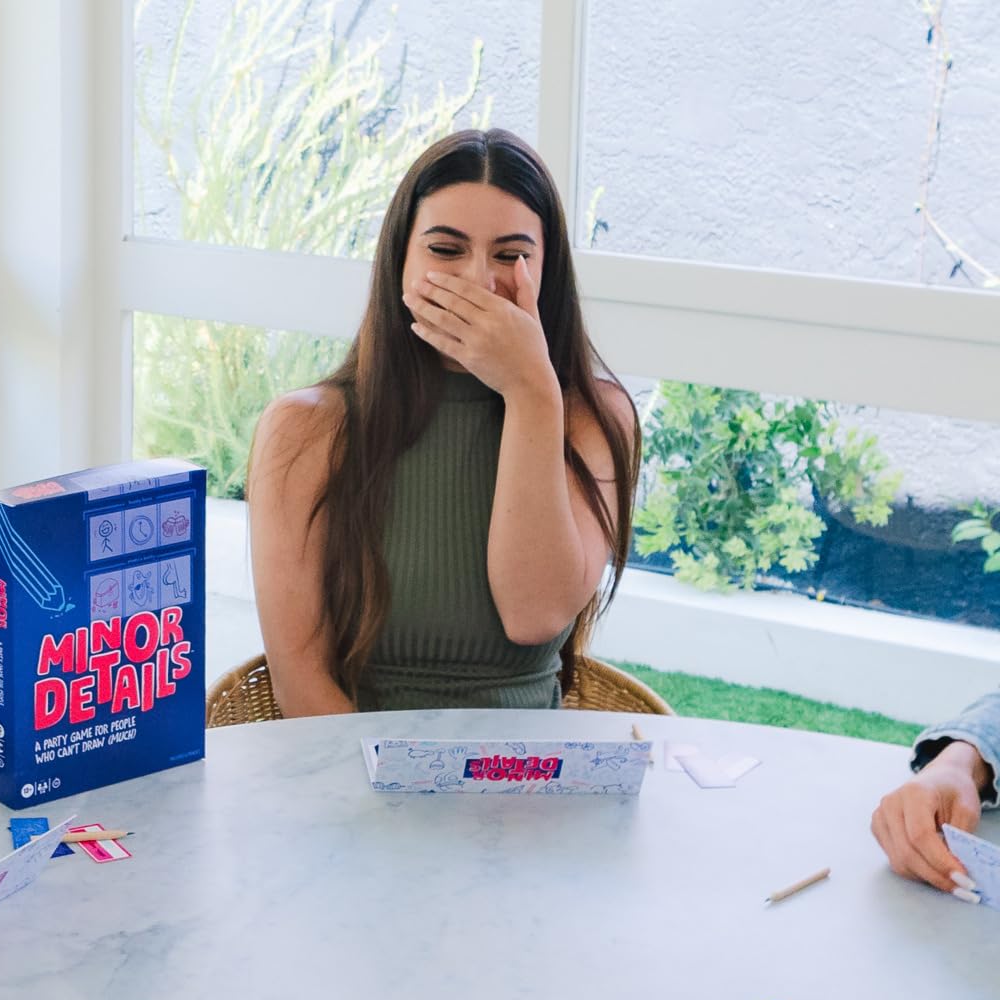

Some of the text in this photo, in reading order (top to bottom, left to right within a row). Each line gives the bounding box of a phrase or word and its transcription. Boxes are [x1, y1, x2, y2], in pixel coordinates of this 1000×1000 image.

[37, 606, 184, 675] MINOR
[34, 641, 192, 730] DETAILS
[35, 716, 136, 752] A PARTY GAME FOR PEOPLE
[35, 729, 137, 764] WHO CAN'T DRAW (MUCH)
[469, 755, 559, 772] DETAILS
[472, 768, 553, 781] MINOR
